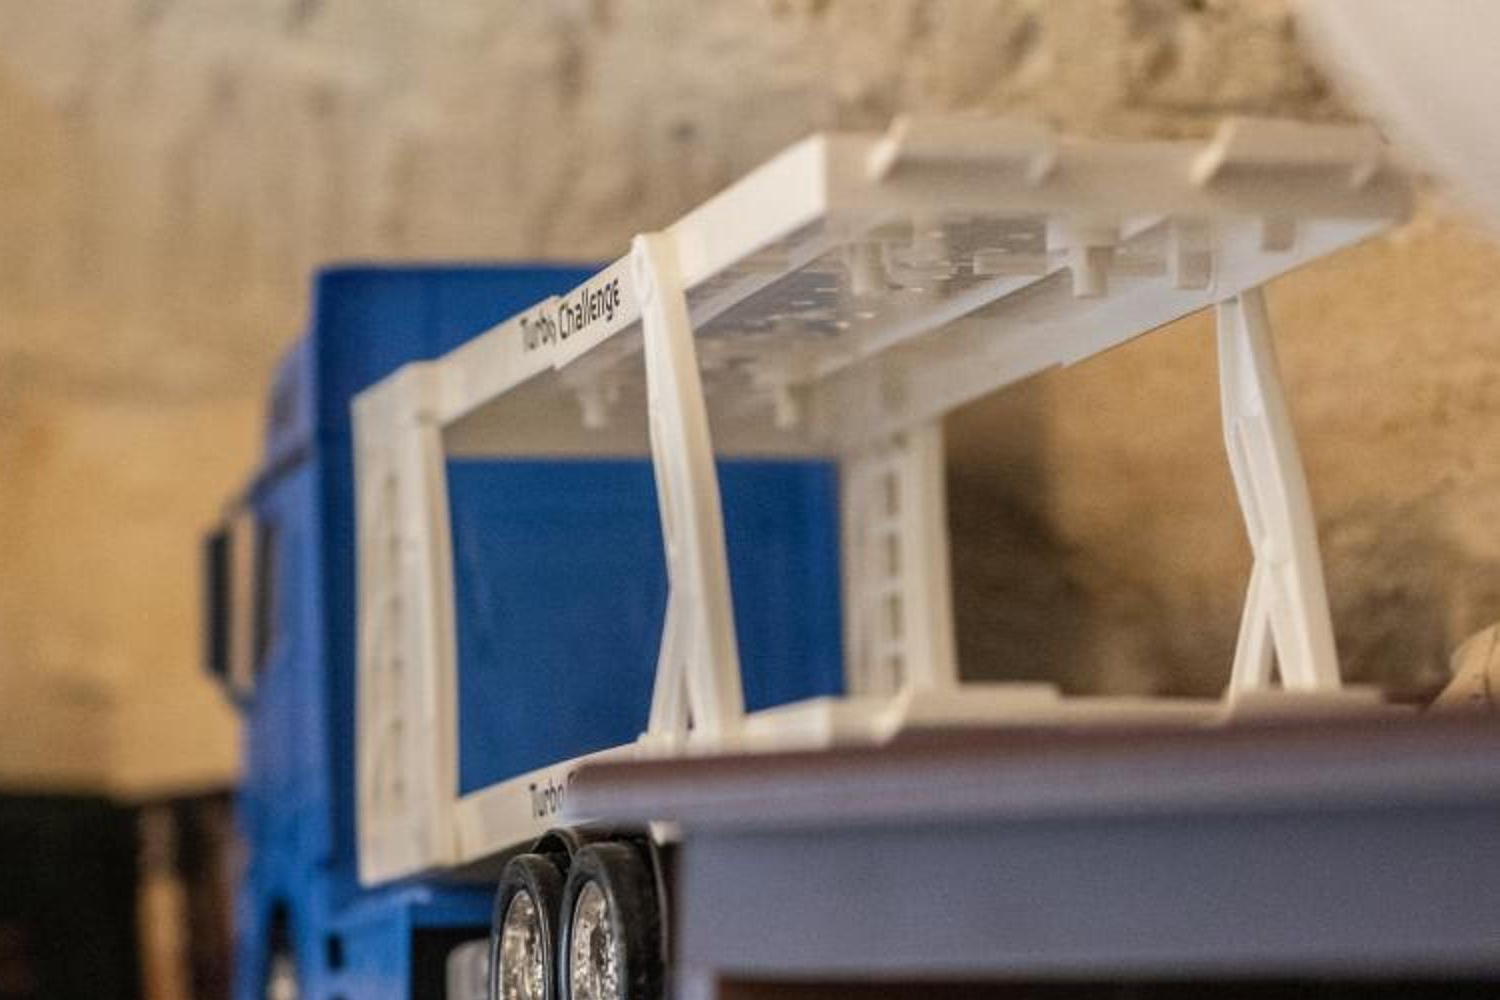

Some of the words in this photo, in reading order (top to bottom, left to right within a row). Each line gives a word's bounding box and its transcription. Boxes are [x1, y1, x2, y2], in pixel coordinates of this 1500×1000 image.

[519, 307, 557, 354] Turbo
[558, 278, 620, 341] Challenge
[529, 777, 565, 818] Turbo
